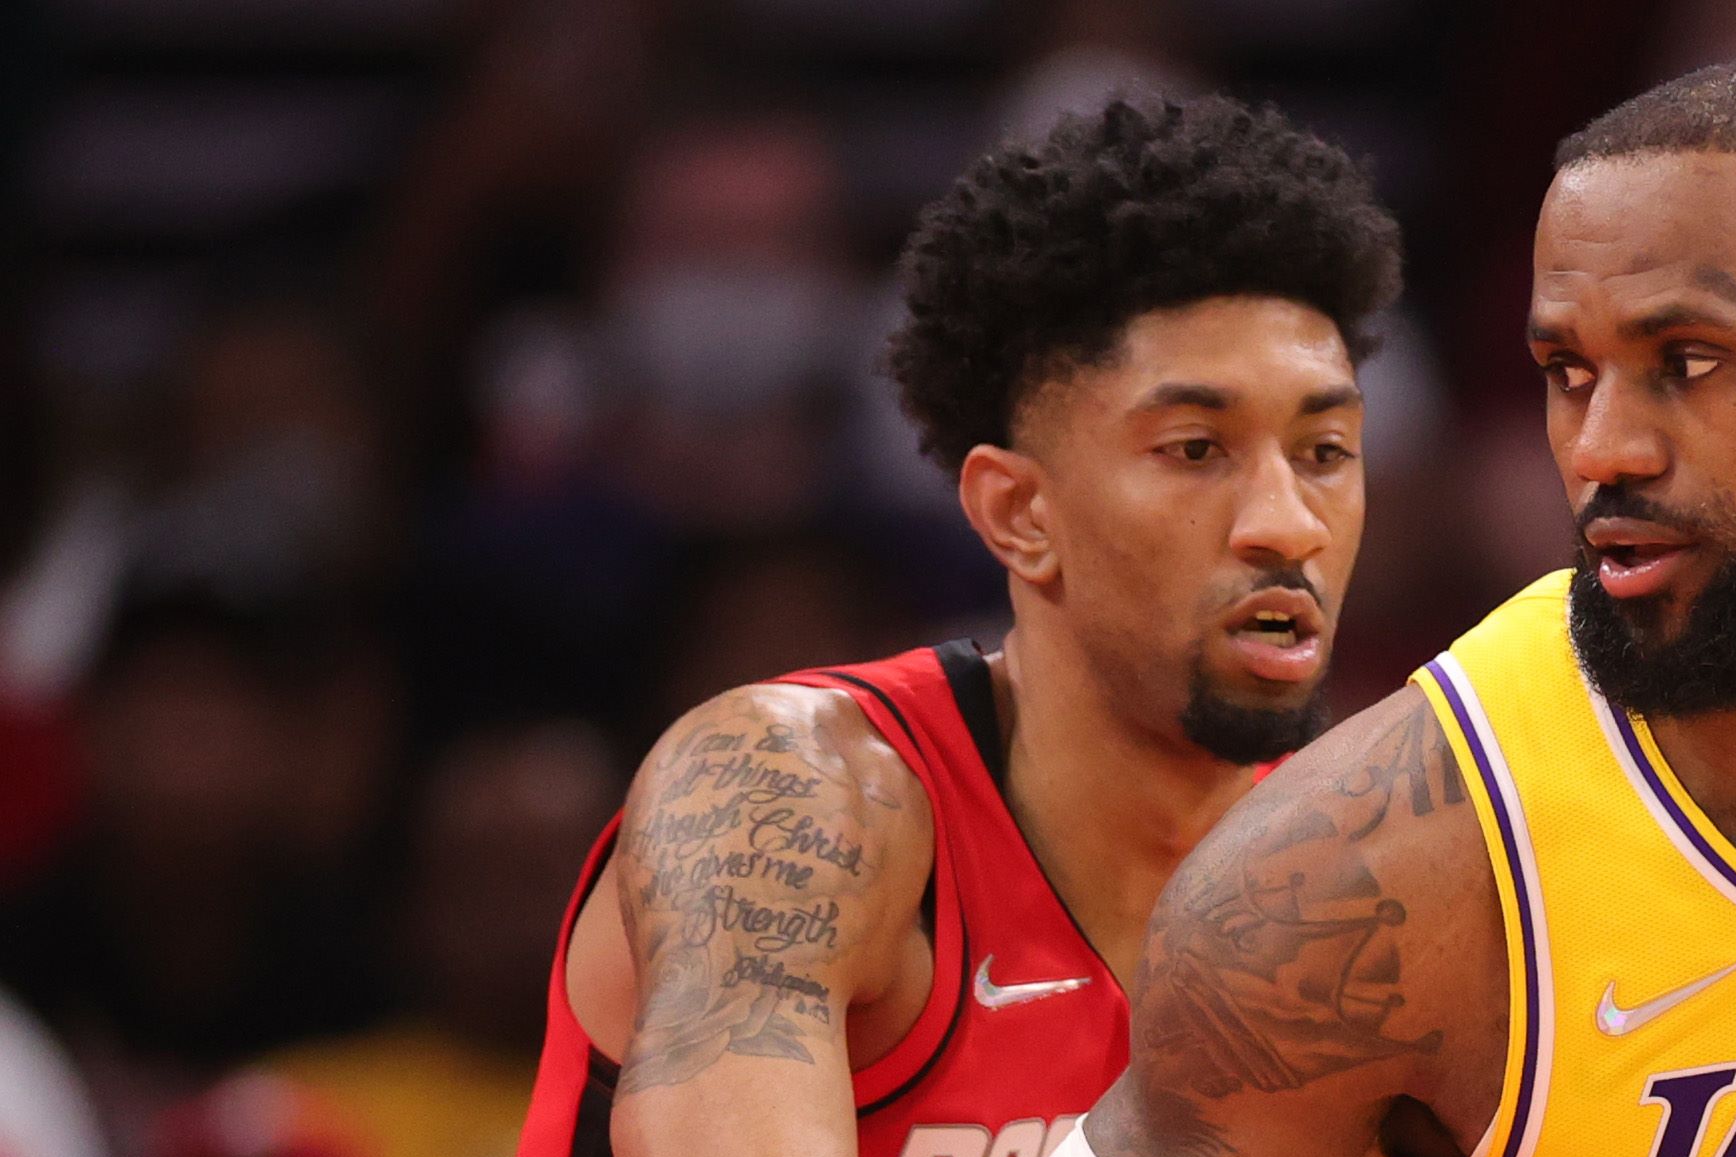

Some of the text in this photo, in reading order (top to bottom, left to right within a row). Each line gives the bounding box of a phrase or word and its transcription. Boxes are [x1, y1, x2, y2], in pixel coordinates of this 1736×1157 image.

[708, 753, 822, 804] things
[748, 807, 869, 877] Christ
[762, 857, 813, 889] me
